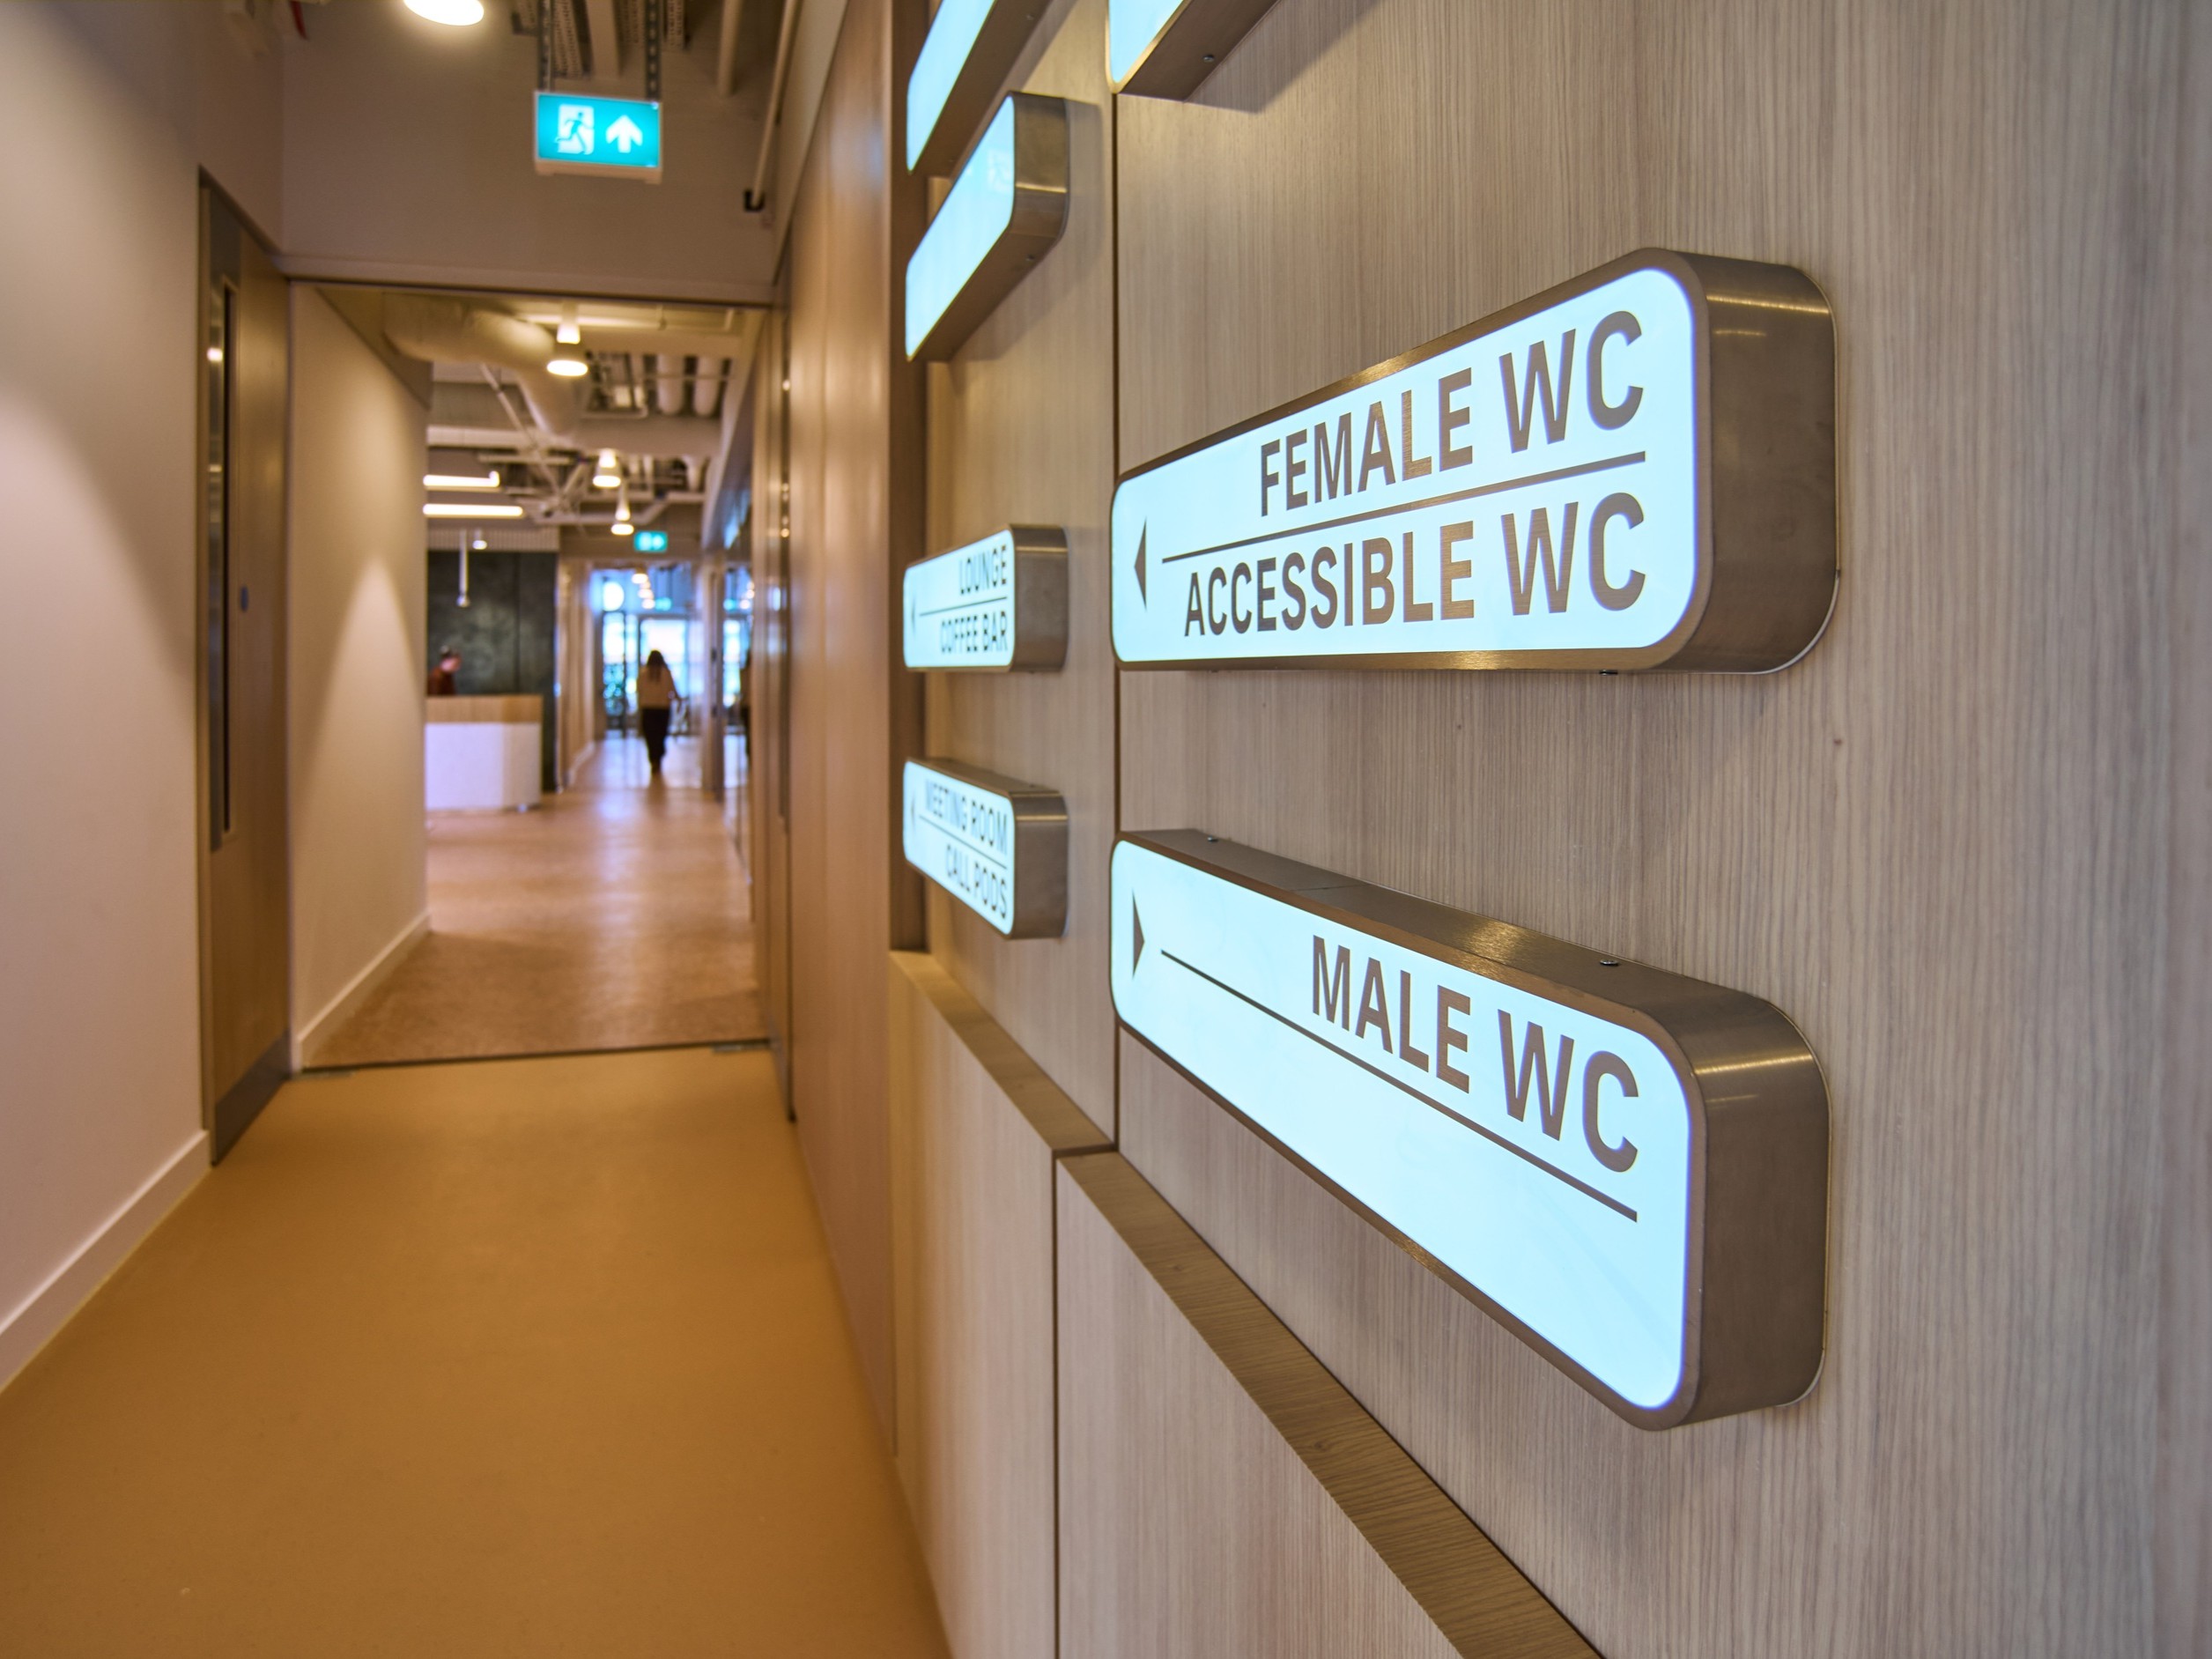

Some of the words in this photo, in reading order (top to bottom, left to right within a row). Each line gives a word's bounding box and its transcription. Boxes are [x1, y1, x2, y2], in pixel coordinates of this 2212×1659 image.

[1261, 367, 1472, 516] FEMALE
[1499, 311, 1644, 454] WC
[959, 544, 1007, 596] LOUNGE
[1184, 521, 1475, 637] ACCESSIBLE
[1501, 492, 1646, 616] WC
[941, 615, 979, 654] COFFEE
[982, 611, 1008, 652] BAR
[971, 799, 1008, 856] ROOM
[946, 843, 971, 892] CALL
[973, 861, 1008, 920] PODS
[1312, 934, 1471, 1094] MALE
[1498, 1009, 1639, 1173] WC
